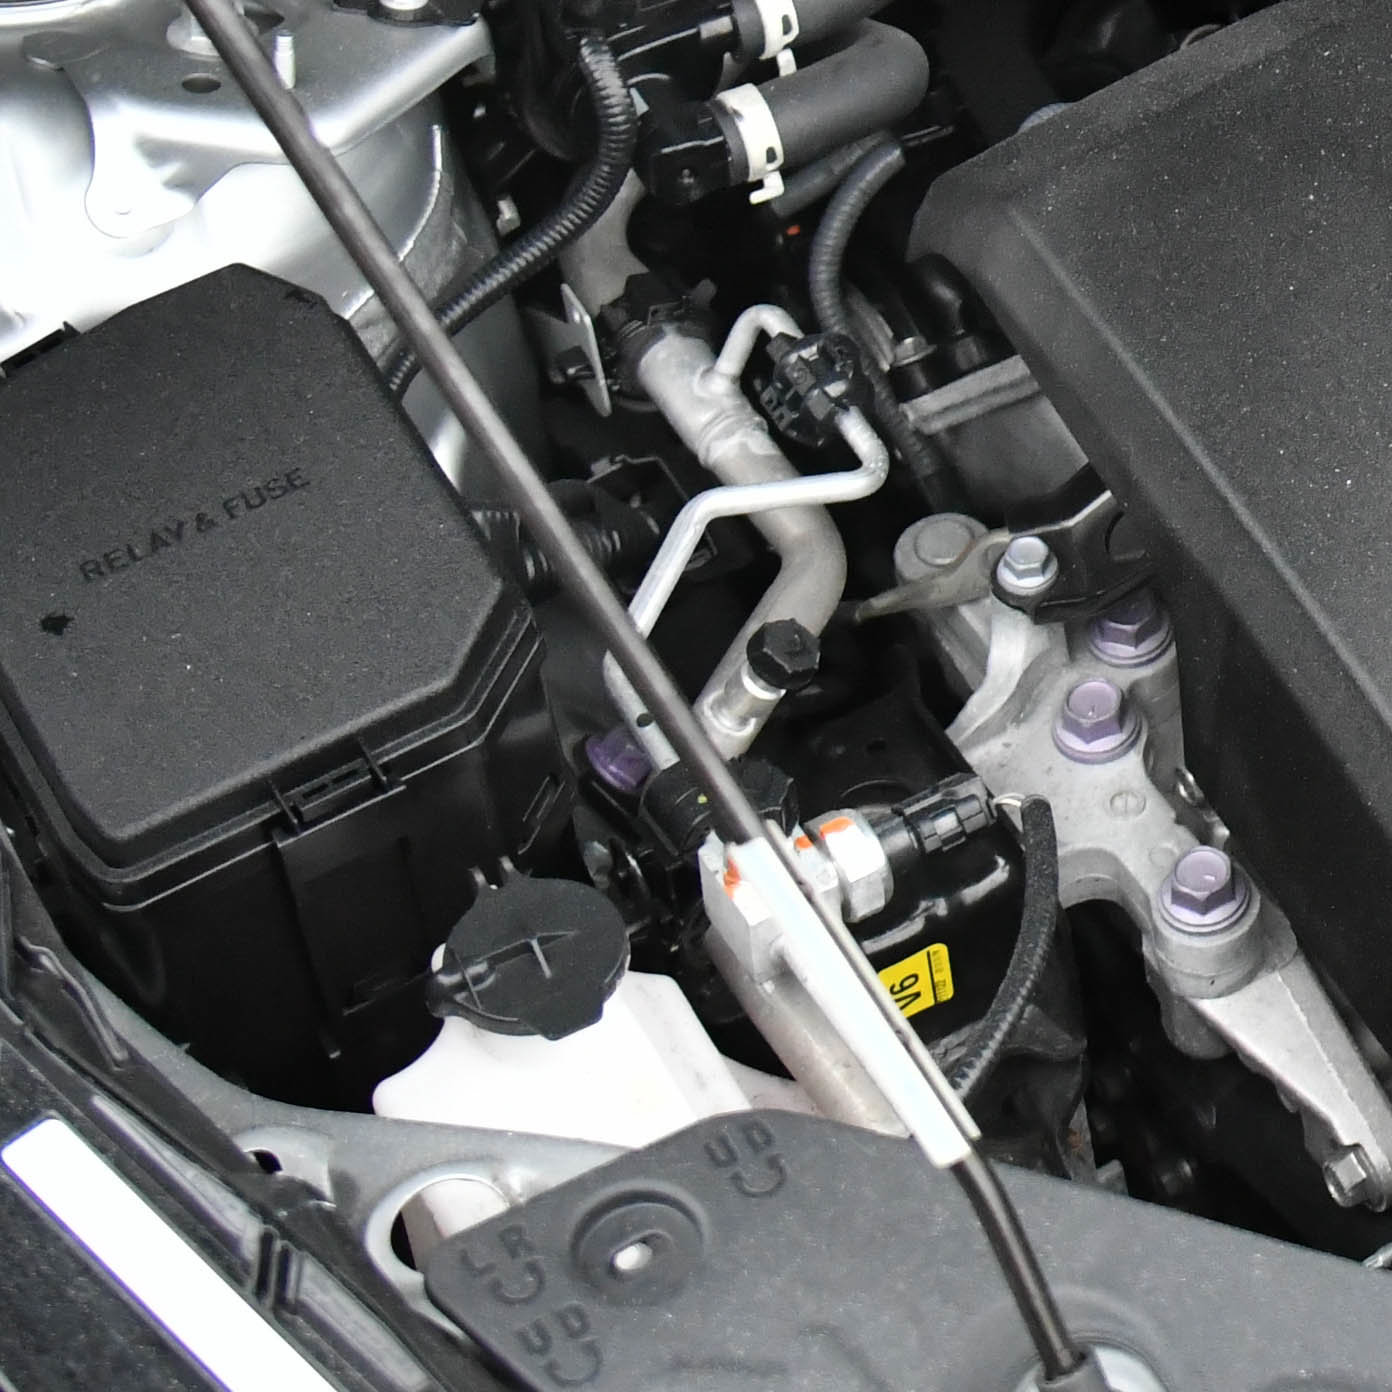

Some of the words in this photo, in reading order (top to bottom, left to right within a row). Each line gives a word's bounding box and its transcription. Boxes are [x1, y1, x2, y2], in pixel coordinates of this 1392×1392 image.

[79, 519, 185, 584] RELAY
[195, 512, 219, 533] &
[222, 467, 311, 520] FUSE
